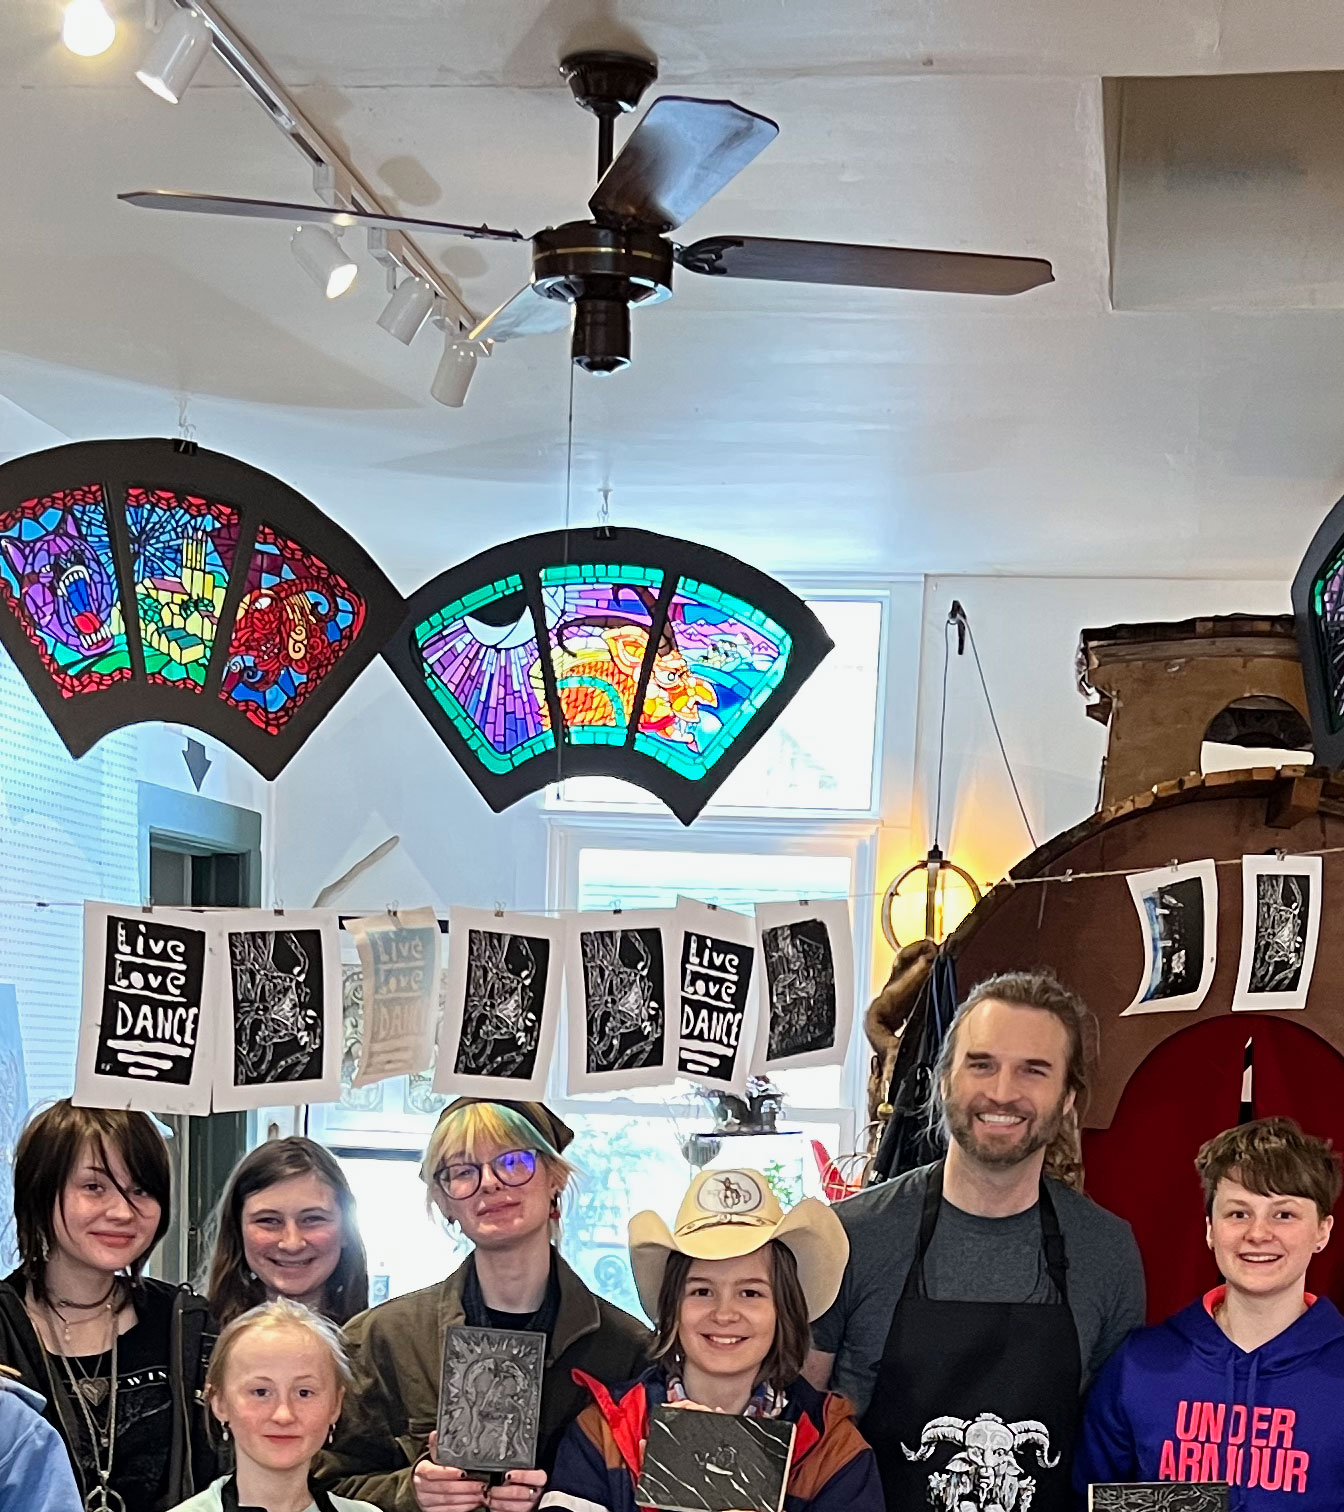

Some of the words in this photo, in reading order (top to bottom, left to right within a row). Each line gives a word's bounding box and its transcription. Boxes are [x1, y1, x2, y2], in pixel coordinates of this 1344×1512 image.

[117, 921, 186, 961] Live
[689, 934, 739, 974] Live
[114, 960, 186, 996] Love
[684, 969, 737, 1002] Love
[116, 1000, 199, 1045] DANCE
[681, 1004, 742, 1046] DANCE
[1175, 1400, 1297, 1448] UNDER
[1158, 1439, 1311, 1494] ARMOUR
